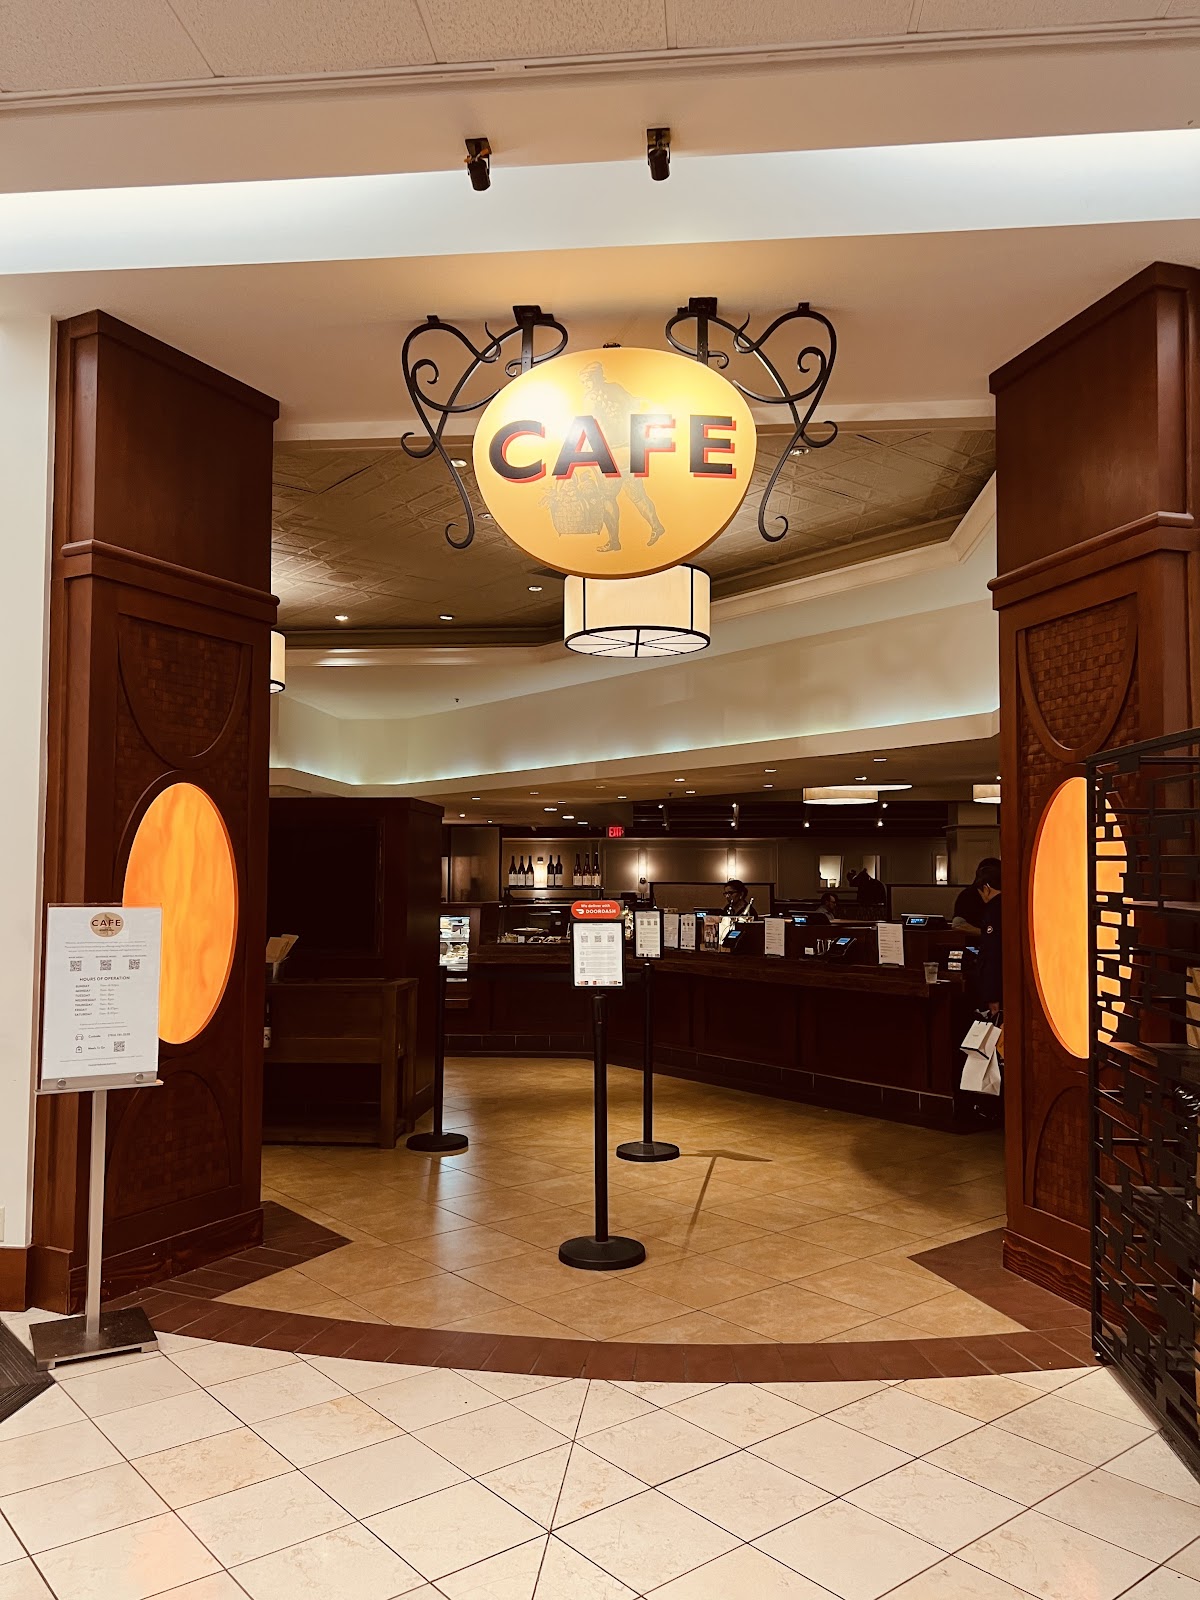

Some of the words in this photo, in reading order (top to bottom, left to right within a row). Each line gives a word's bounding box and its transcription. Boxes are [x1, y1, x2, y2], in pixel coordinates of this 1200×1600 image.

[488, 413, 736, 484] CAFE
[608, 826, 622, 837] EXIT
[91, 919, 121, 927] CAFE
